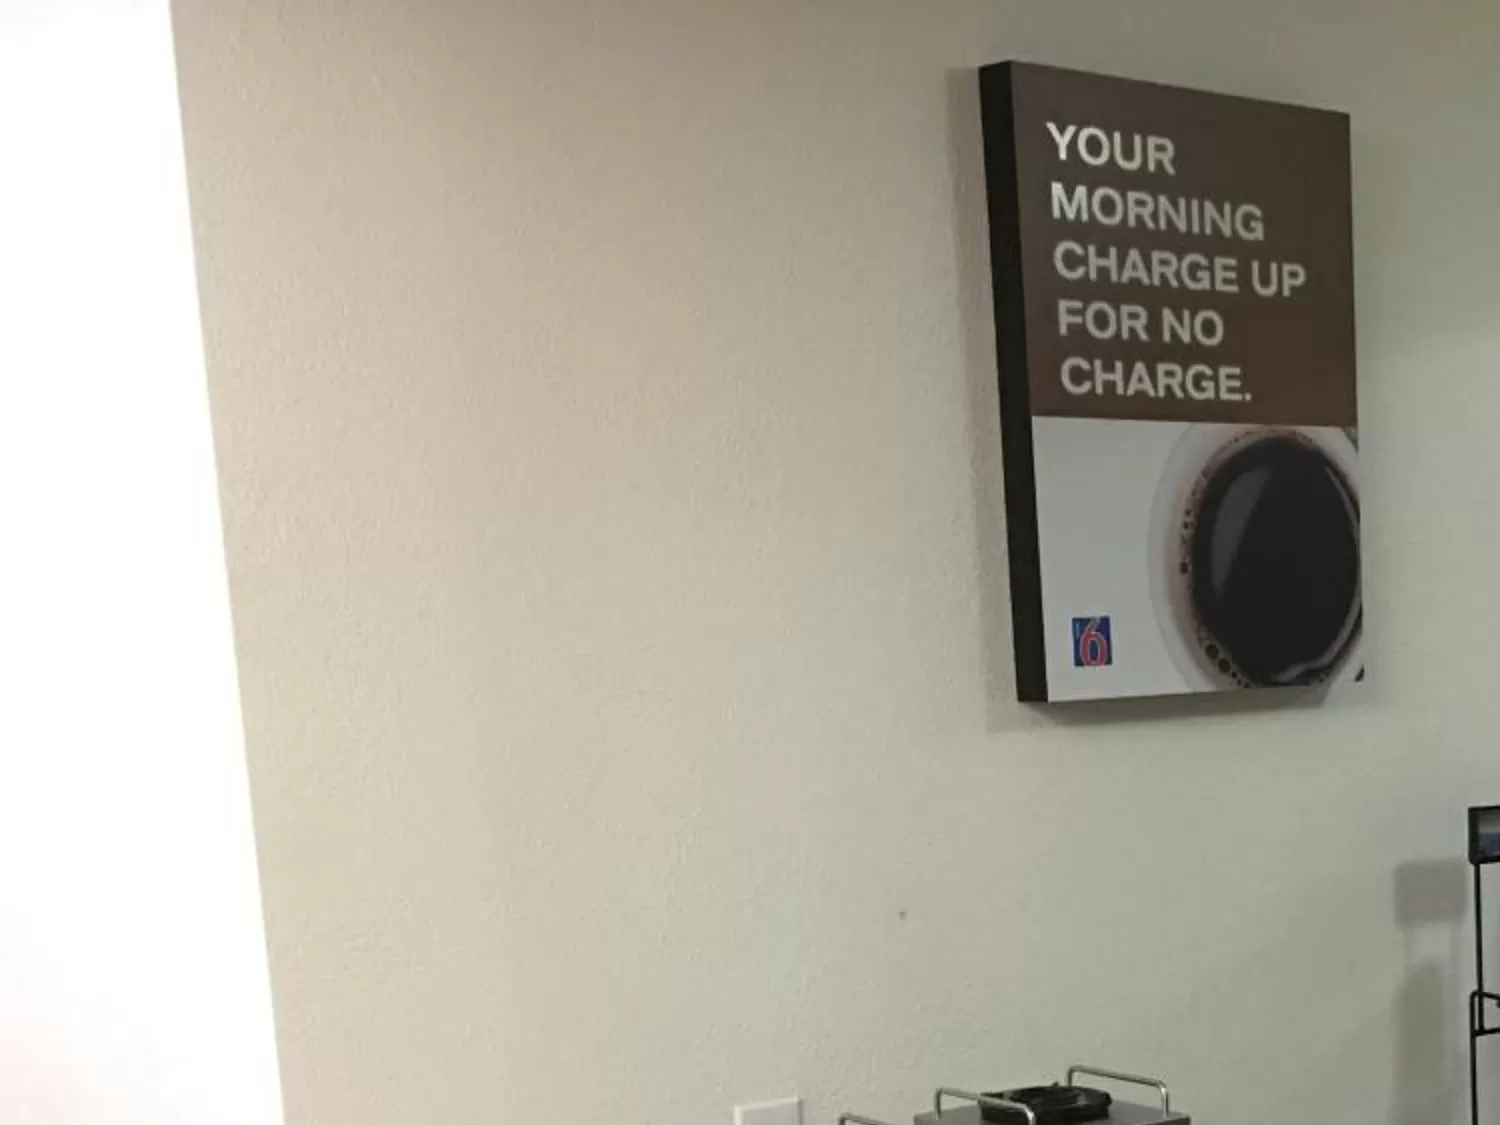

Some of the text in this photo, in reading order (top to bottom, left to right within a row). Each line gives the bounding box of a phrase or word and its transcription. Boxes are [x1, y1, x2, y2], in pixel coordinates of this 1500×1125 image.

[1046, 121, 1175, 175] YOUR
[1051, 181, 1264, 241] MORNING
[1053, 241, 1306, 298] CHARGE UP
[1057, 299, 1224, 346] FOR NO
[1060, 356, 1252, 401] CHARGE.
[1080, 616, 1108, 667] 6
